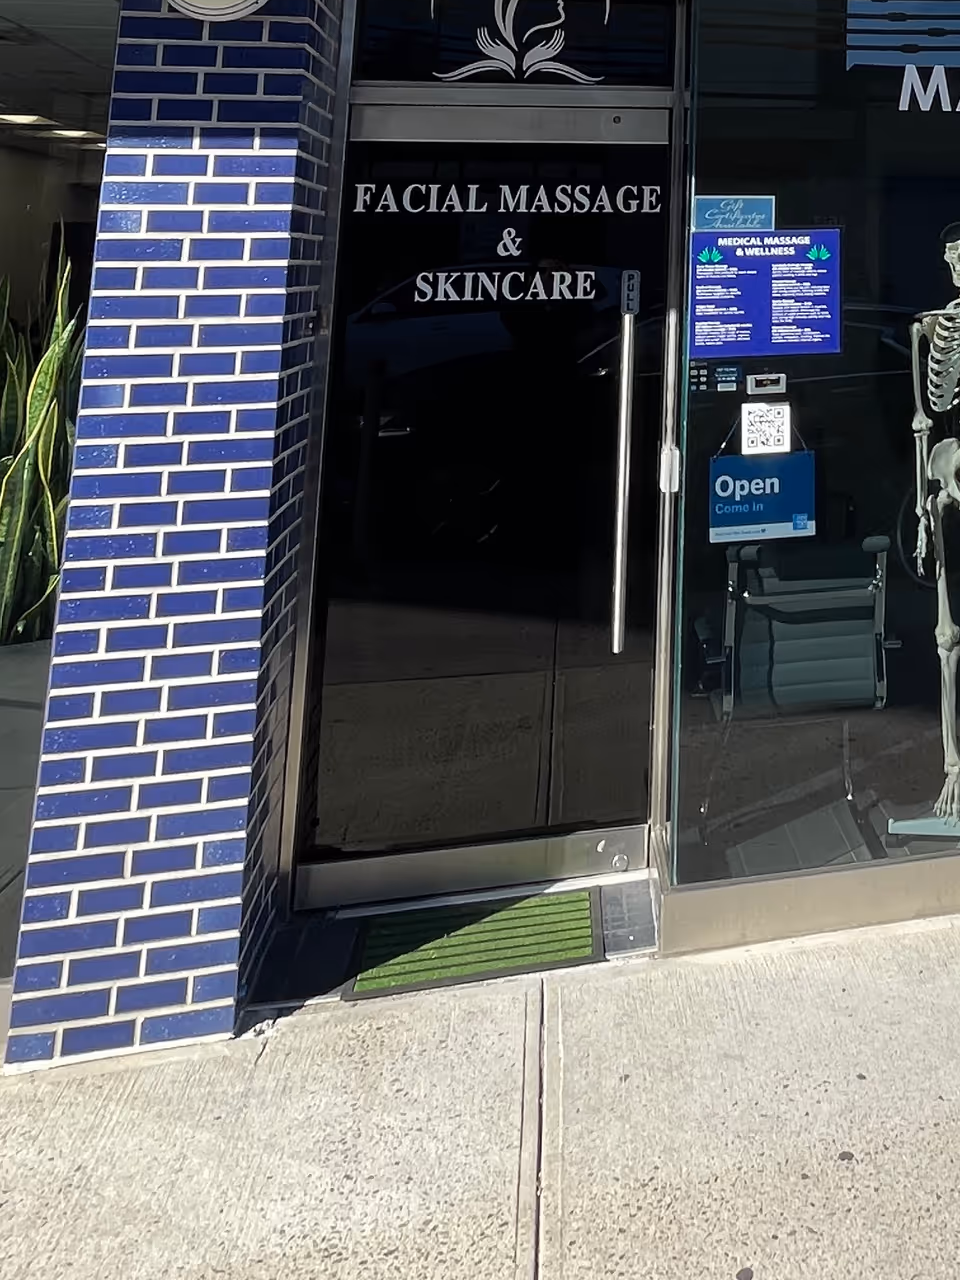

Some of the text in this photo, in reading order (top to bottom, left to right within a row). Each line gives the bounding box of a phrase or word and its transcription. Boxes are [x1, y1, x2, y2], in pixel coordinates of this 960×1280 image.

[353, 183, 662, 214] FACIAL MASSAGE
[497, 227, 523, 257] &
[717, 235, 811, 247] MEDICAL MASSAGE
[735, 246, 796, 257] & WELLNESS
[414, 271, 597, 302] SKINCARE
[626, 273, 635, 312] PULL
[714, 474, 780, 502] Open
[714, 500, 764, 515] Come In
